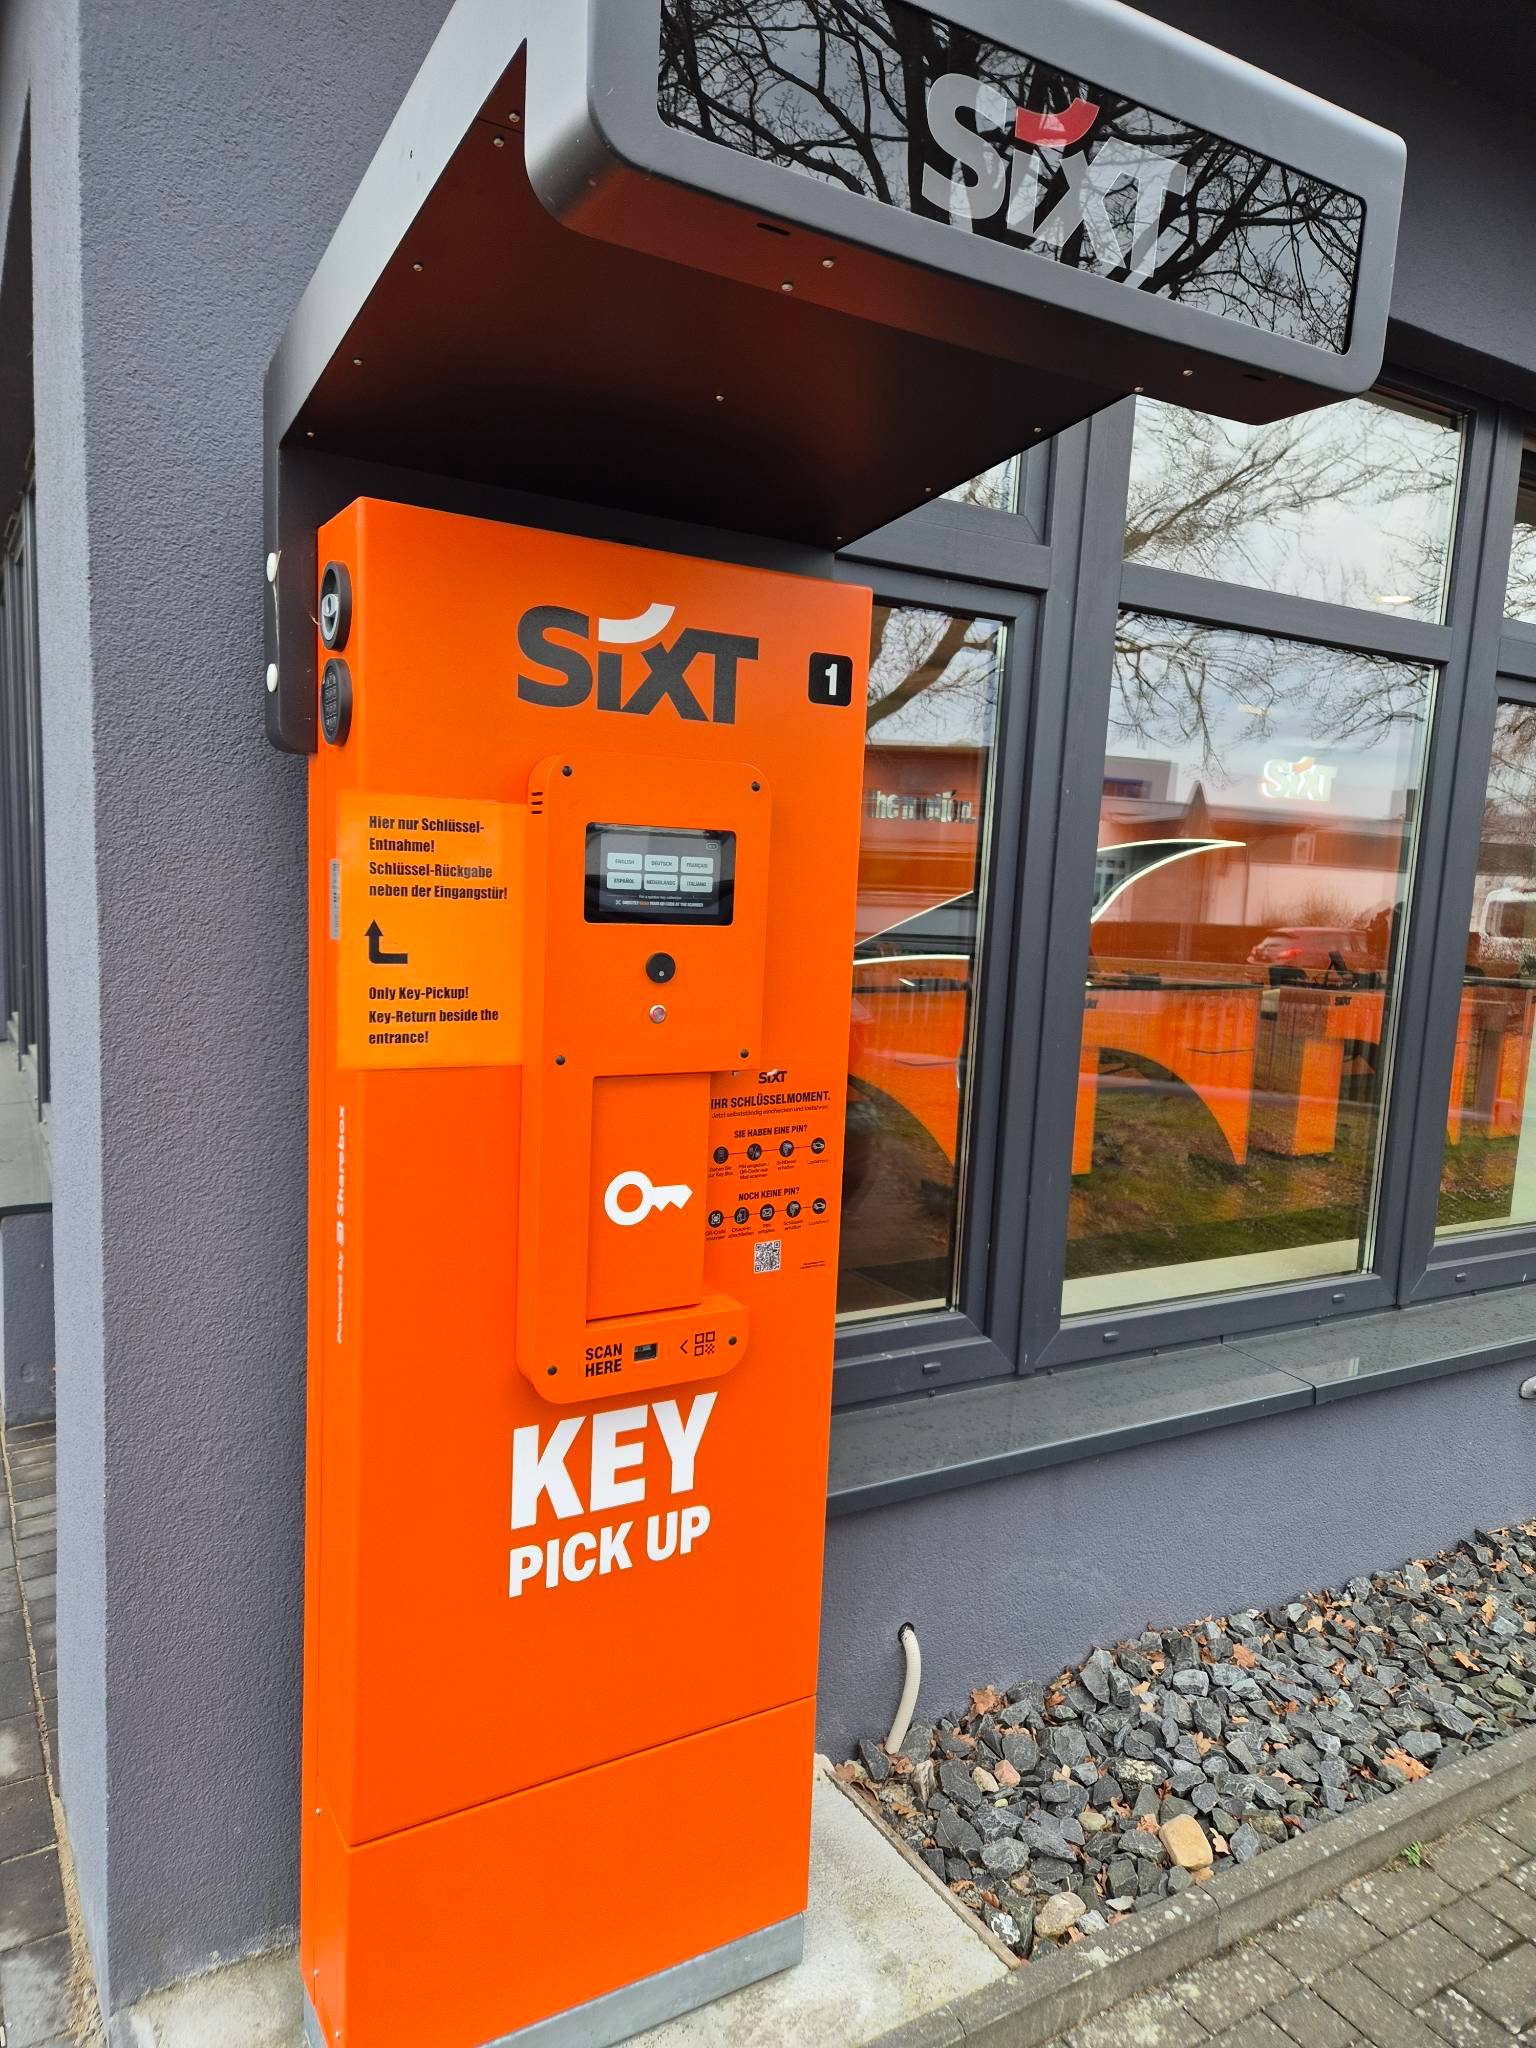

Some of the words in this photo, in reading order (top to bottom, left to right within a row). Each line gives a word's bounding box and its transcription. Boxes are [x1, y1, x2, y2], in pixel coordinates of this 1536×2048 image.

[824, 663, 838, 696] 1
[369, 816, 395, 829] Hier
[398, 819, 419, 831] nur
[422, 818, 484, 833] Schlüssel-
[369, 838, 435, 853] Entnahme!
[369, 861, 493, 879] Schlüssel-Rückgabe
[369, 884, 408, 897] neben
[411, 885, 431, 898] der
[434, 886, 507, 900] Eingangstür!
[369, 987, 396, 1001] Only
[399, 986, 469, 1000] Key-Pickup!
[369, 1010, 436, 1024] Key-Return
[439, 1009, 478, 1022] beside
[480, 1008, 499, 1021] the
[369, 1031, 429, 1045] entrance!
[711, 1098, 728, 1109] IHR
[731, 1090, 831, 1108] SCHLÜSSELMOMENT.
[734, 1129, 746, 1138] SIE
[747, 1127, 772, 1137] HABEN
[774, 1125, 790, 1135] EINE
[791, 1124, 808, 1133] PIN?
[738, 1191, 760, 1201] NOCH
[760, 1188, 782, 1199] KEINE
[783, 1186, 800, 1196] PIN?
[585, 1343, 623, 1361] SCAN
[585, 1358, 622, 1377] HERE
[511, 1391, 719, 1531] KEY
[508, 1521, 634, 1598] PICK
[646, 1505, 711, 1562] UP
